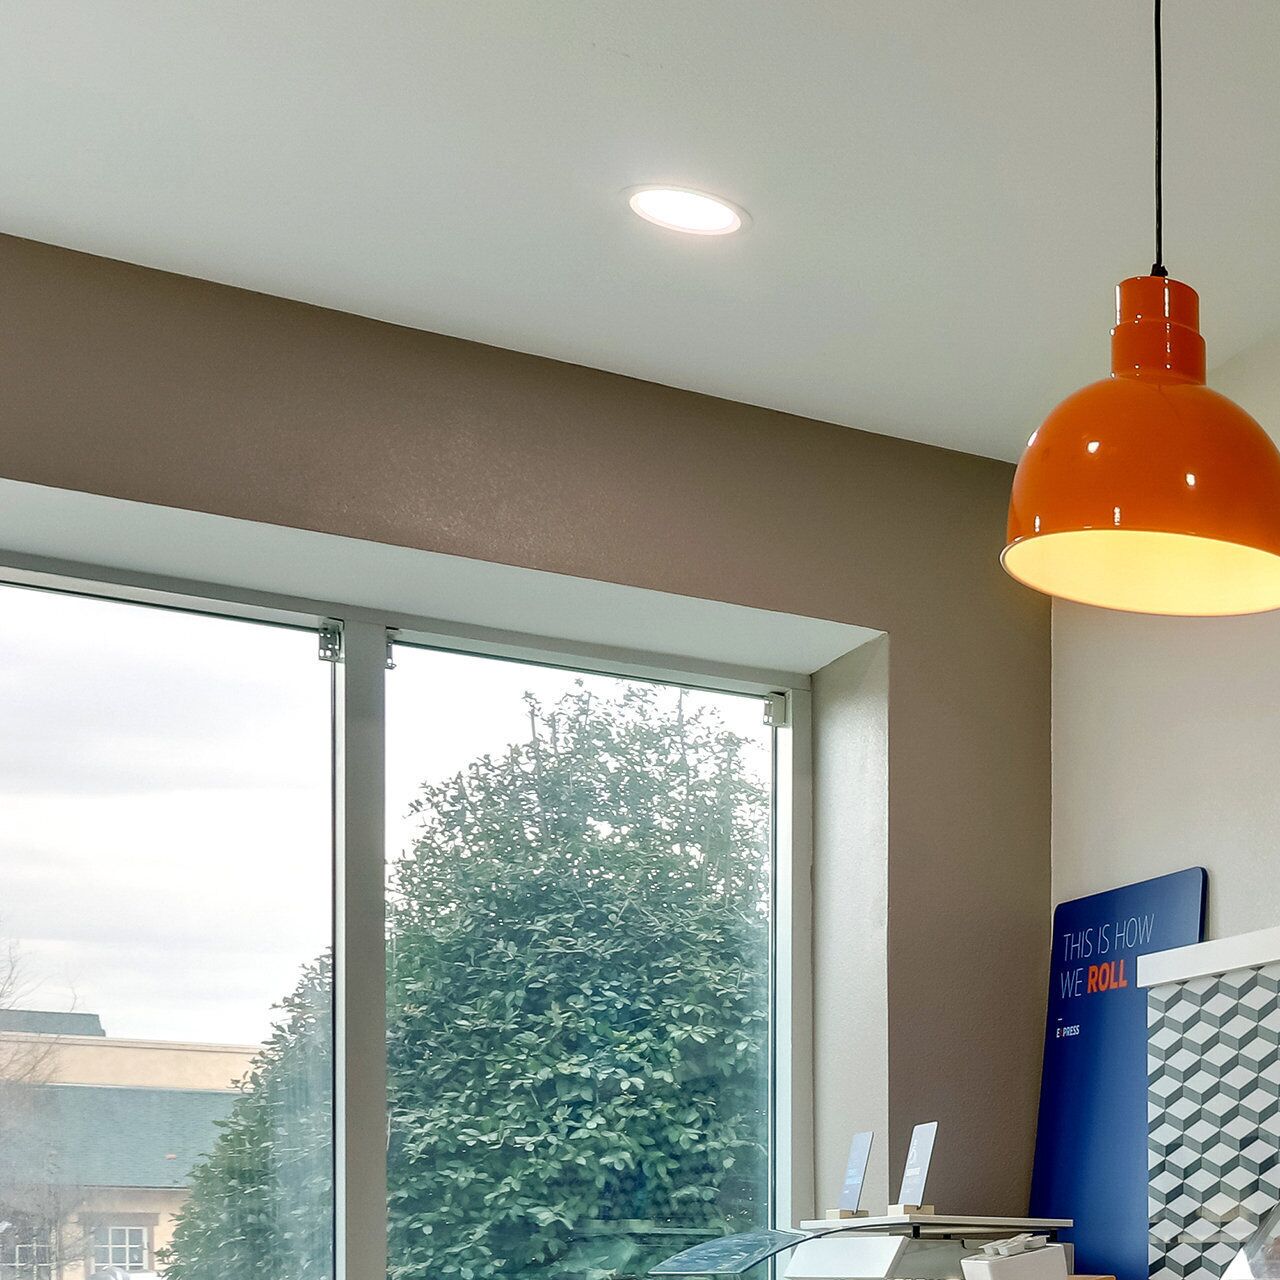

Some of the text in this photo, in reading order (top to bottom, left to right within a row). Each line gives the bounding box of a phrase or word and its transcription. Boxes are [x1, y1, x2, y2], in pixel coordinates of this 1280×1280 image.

[1063, 913, 1155, 962] THIS IS HOW
[1060, 959, 1128, 999] WE ROLL
[1056, 1025, 1080, 1038] EPRESS
